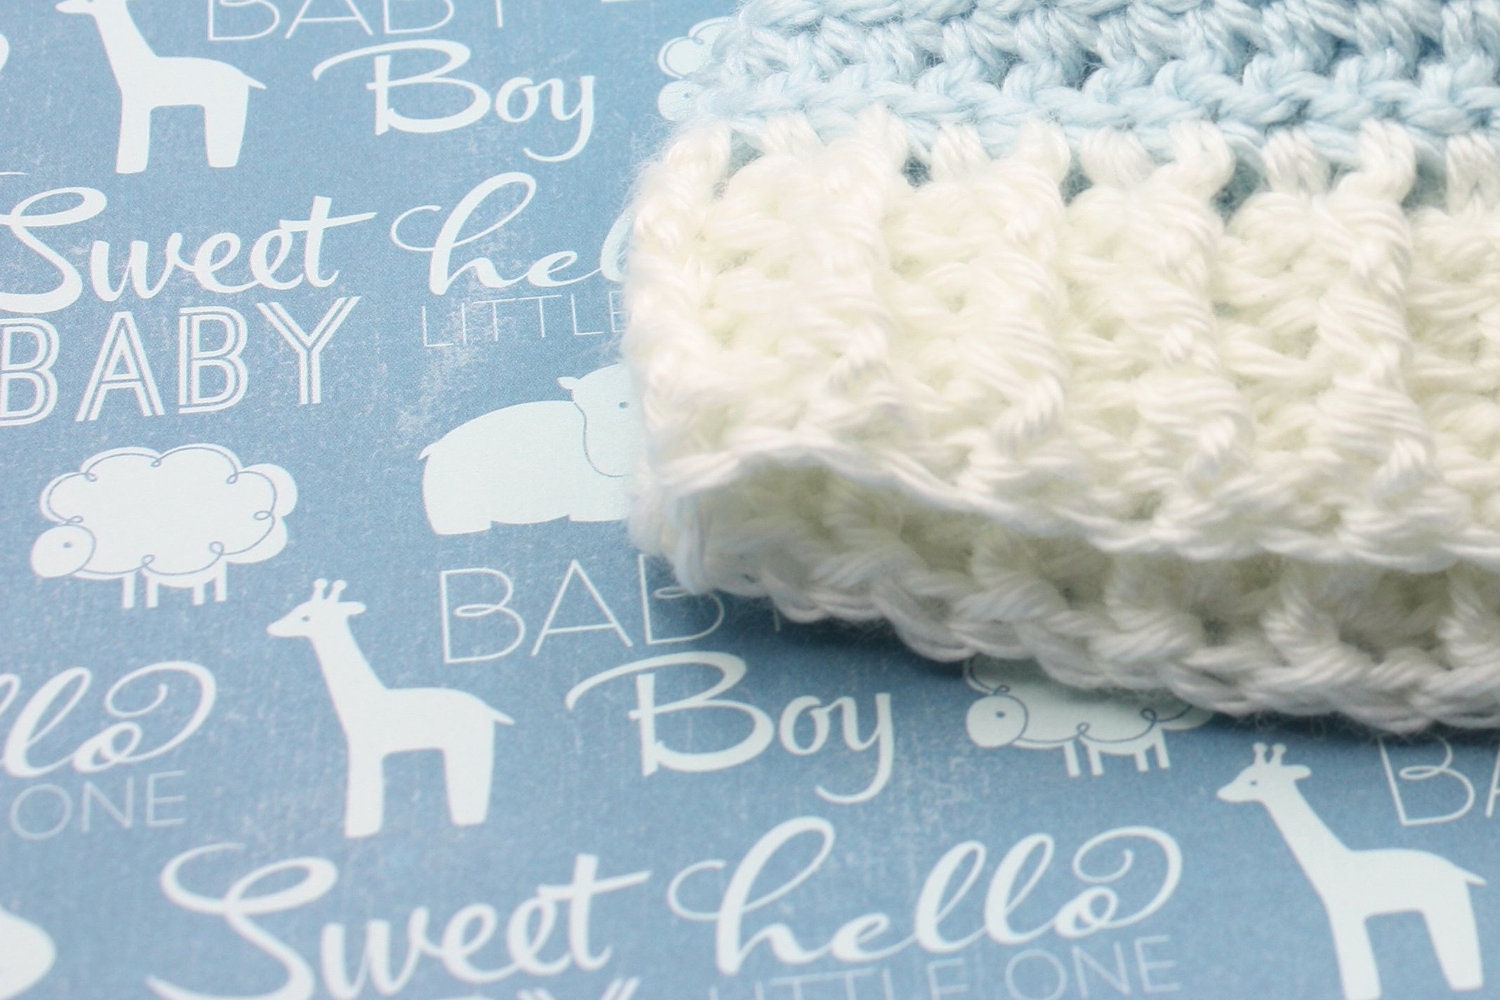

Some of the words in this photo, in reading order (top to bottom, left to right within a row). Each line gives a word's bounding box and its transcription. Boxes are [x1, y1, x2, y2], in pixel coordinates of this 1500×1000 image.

[311, 38, 596, 163] Boy
[0, 172, 378, 314] Sweet
[0, 295, 362, 427] BABY
[439, 552, 780, 665] BAB
[564, 650, 895, 804] Boy
[8, 768, 189, 842] ONE
[145, 842, 653, 1000] Sweet
[666, 815, 1184, 976] hello
